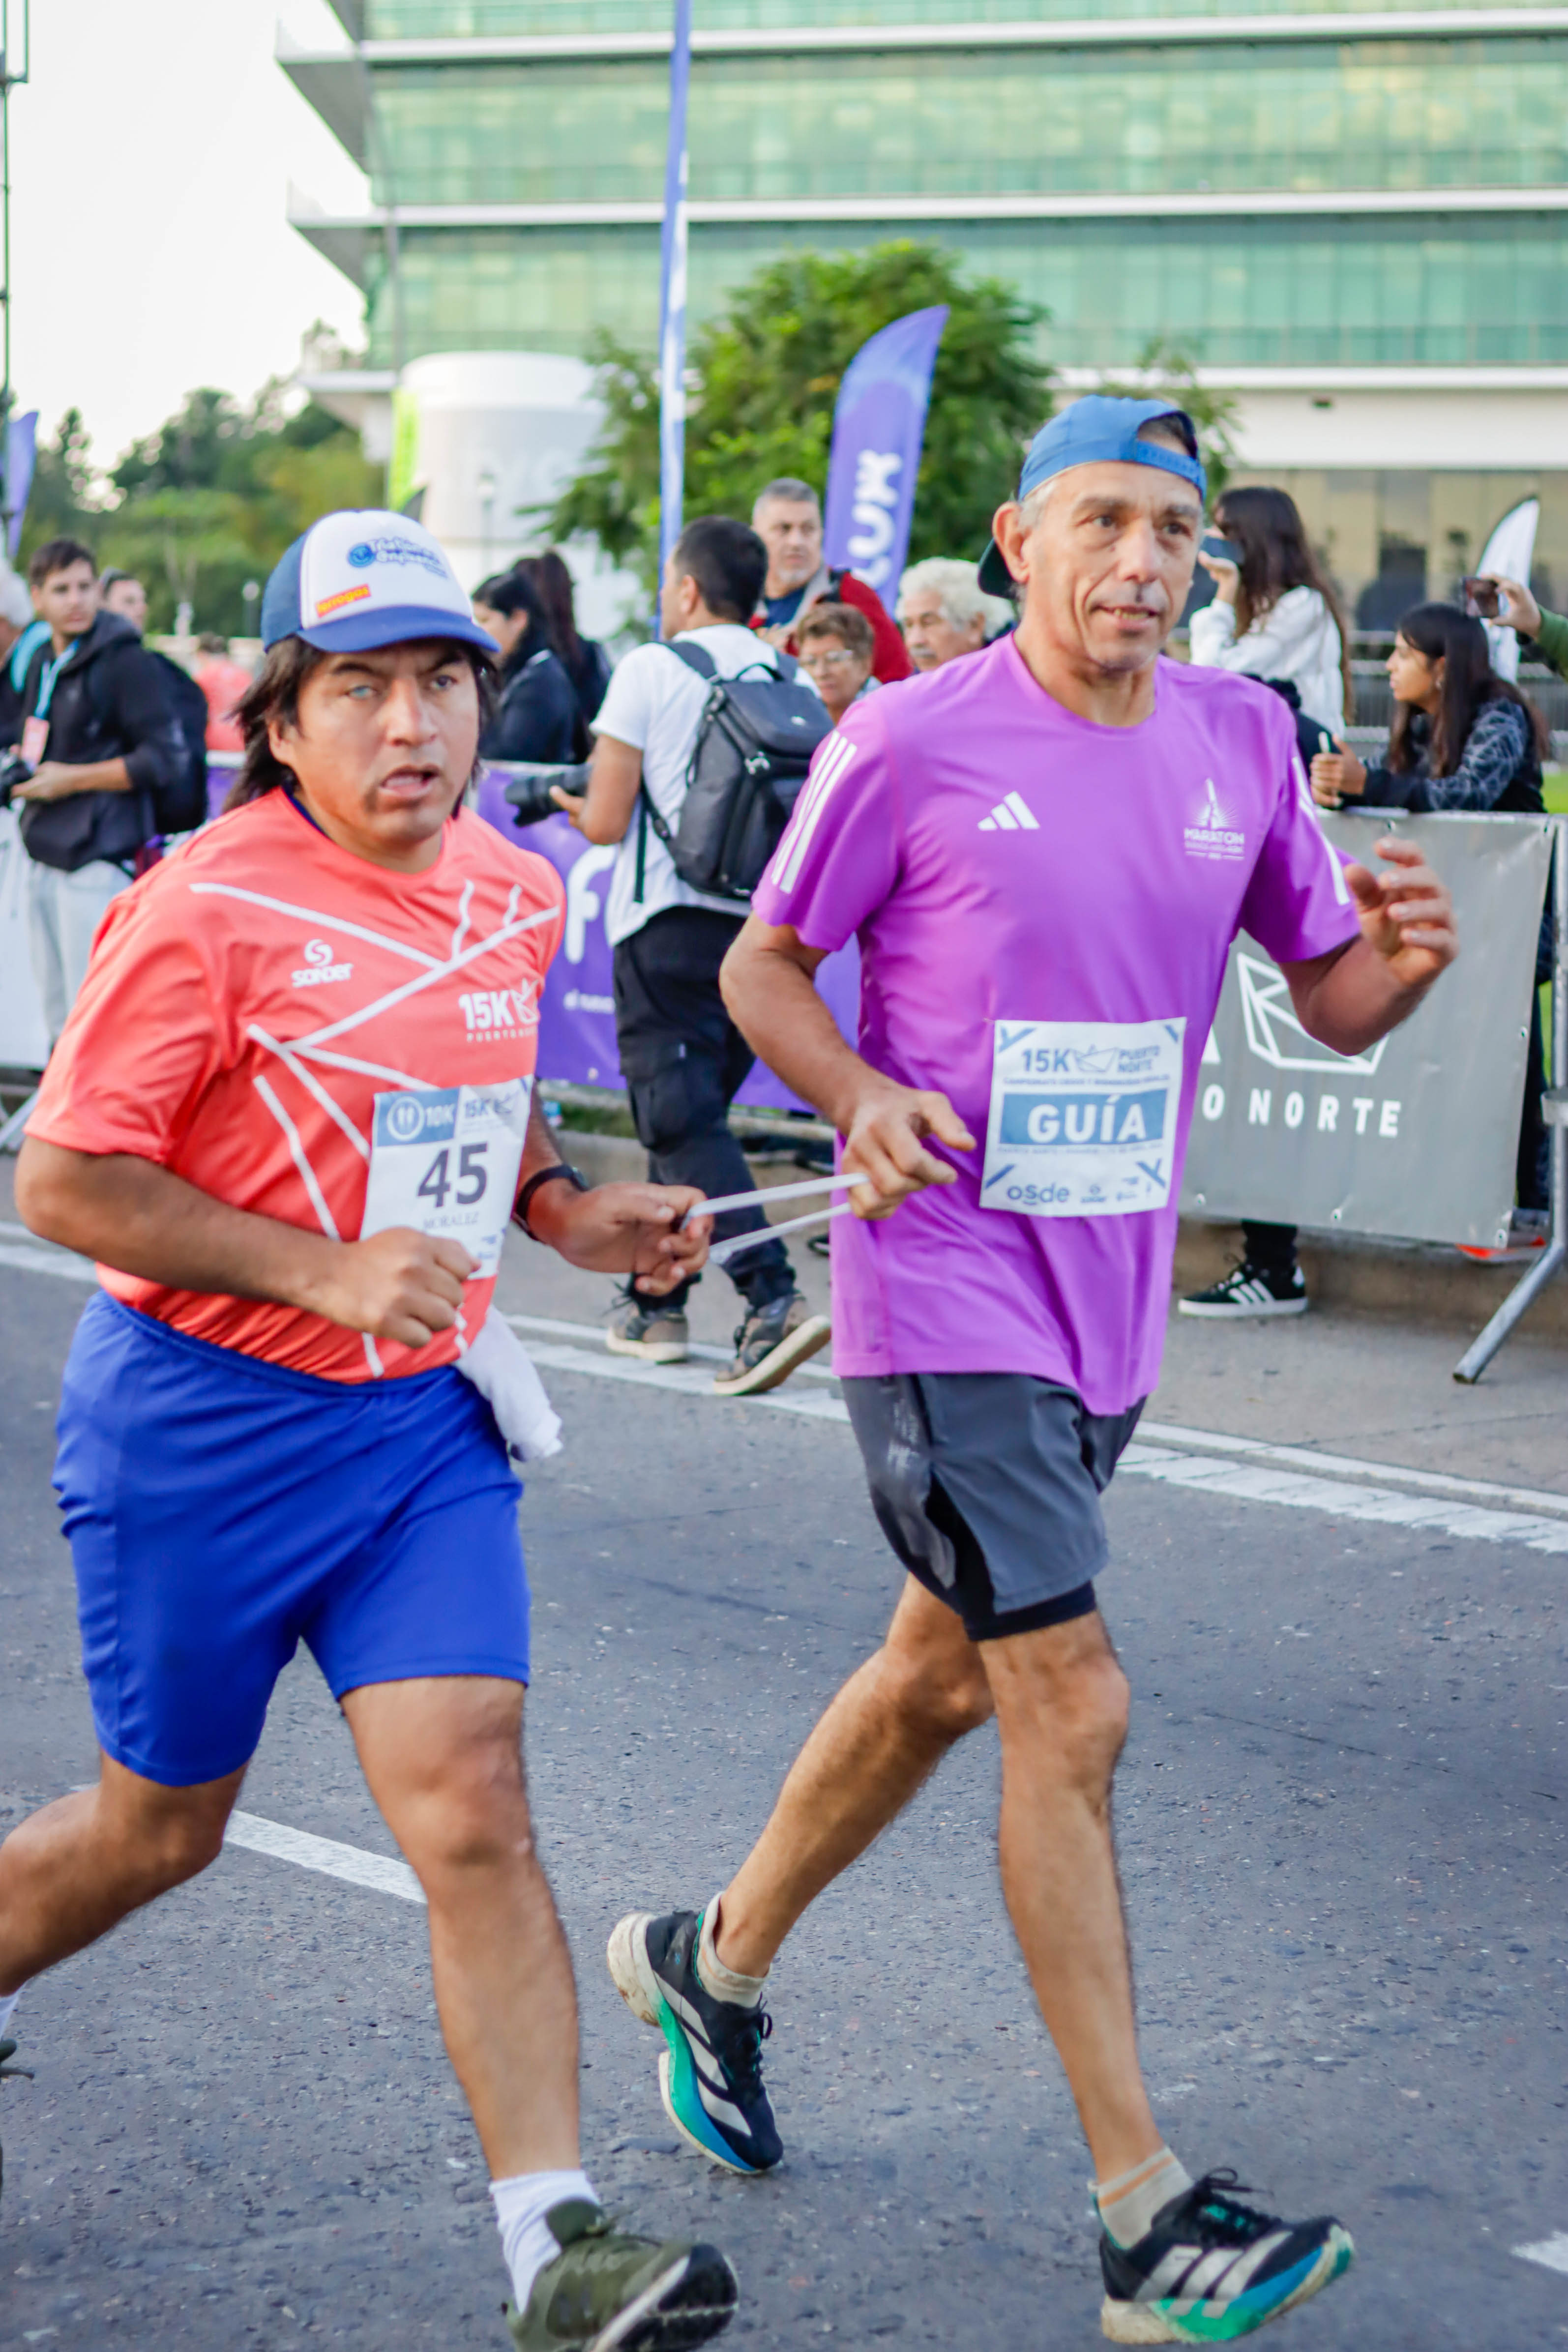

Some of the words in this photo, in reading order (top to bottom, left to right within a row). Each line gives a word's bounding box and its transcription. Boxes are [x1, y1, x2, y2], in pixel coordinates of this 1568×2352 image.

[458, 990, 515, 1030] 15K
[1022, 1048, 1070, 1072] 15K
[1027, 1094, 1146, 1144] GUÍA
[1248, 1088, 1402, 1139] NORTE
[417, 1141, 488, 1208] 45
[1007, 1181, 1069, 1205] osde
